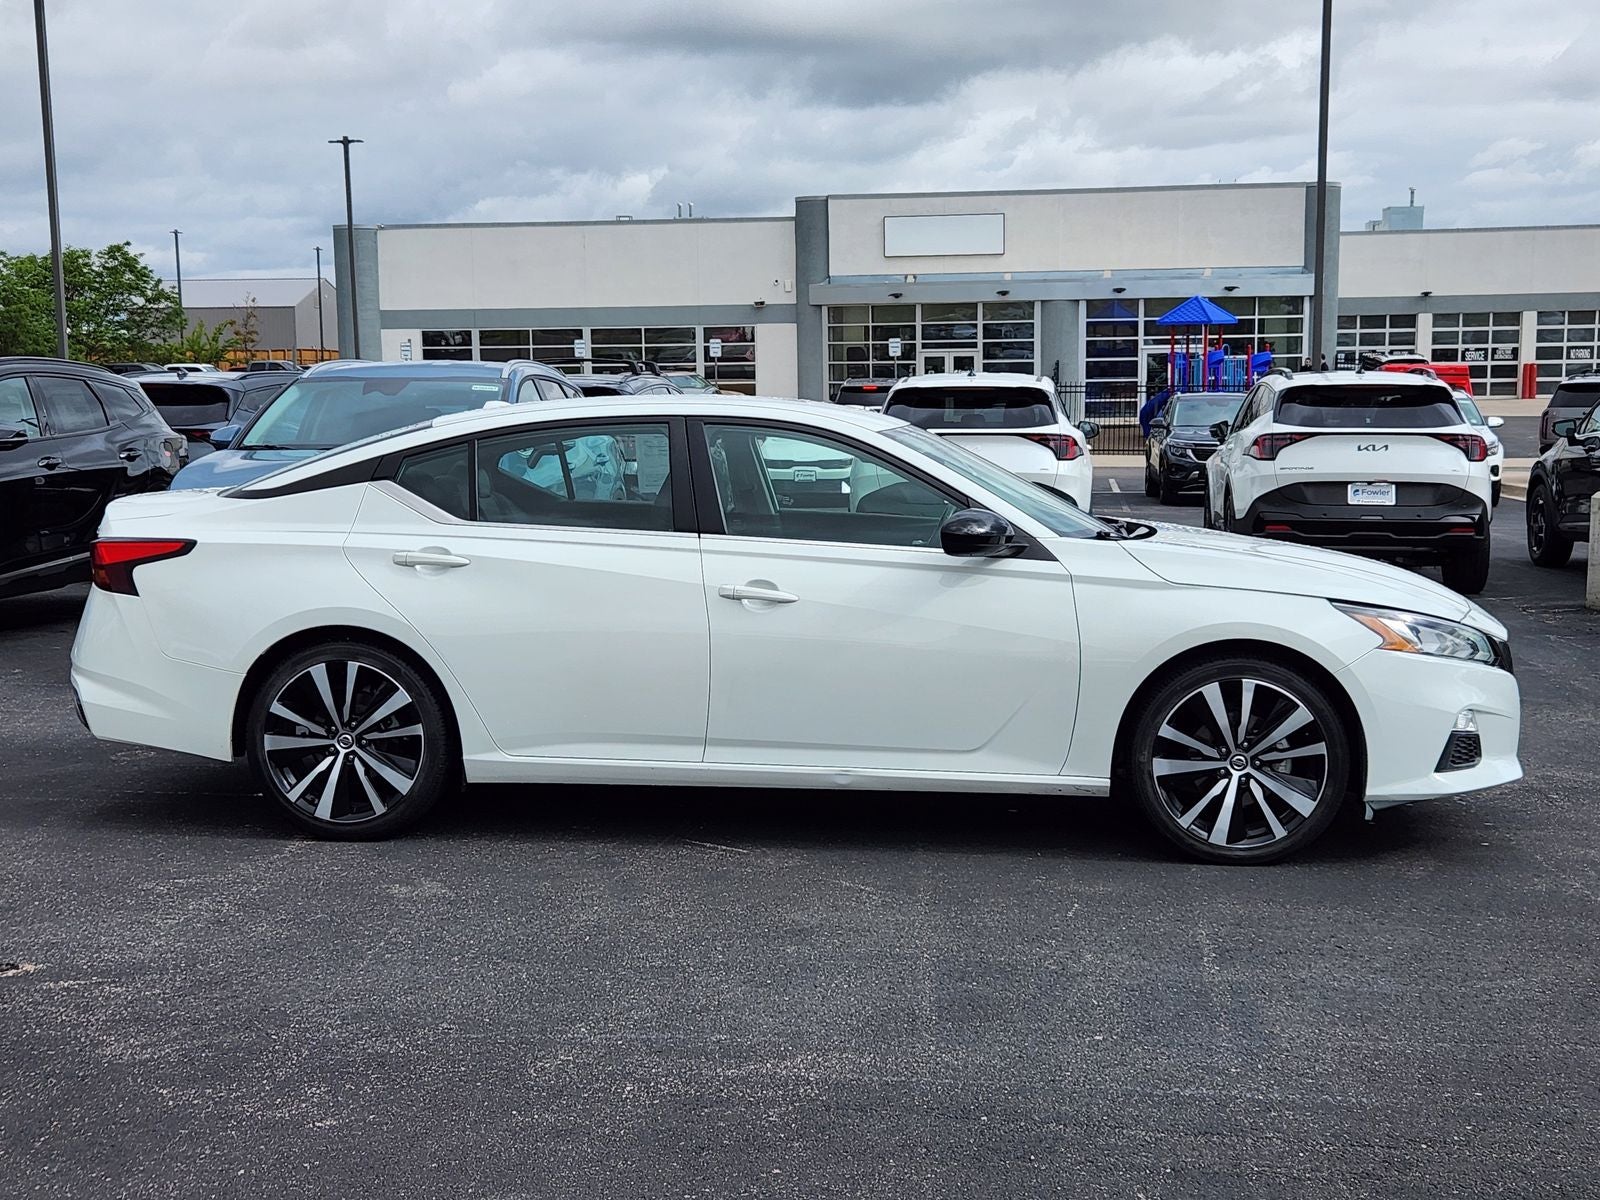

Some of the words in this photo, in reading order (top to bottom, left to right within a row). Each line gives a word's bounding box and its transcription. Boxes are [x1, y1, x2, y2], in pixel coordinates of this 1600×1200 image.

[1465, 351, 1485, 360] SERVICE
[1357, 444, 1389, 452] KIA
[1361, 488, 1390, 497] Fowler
